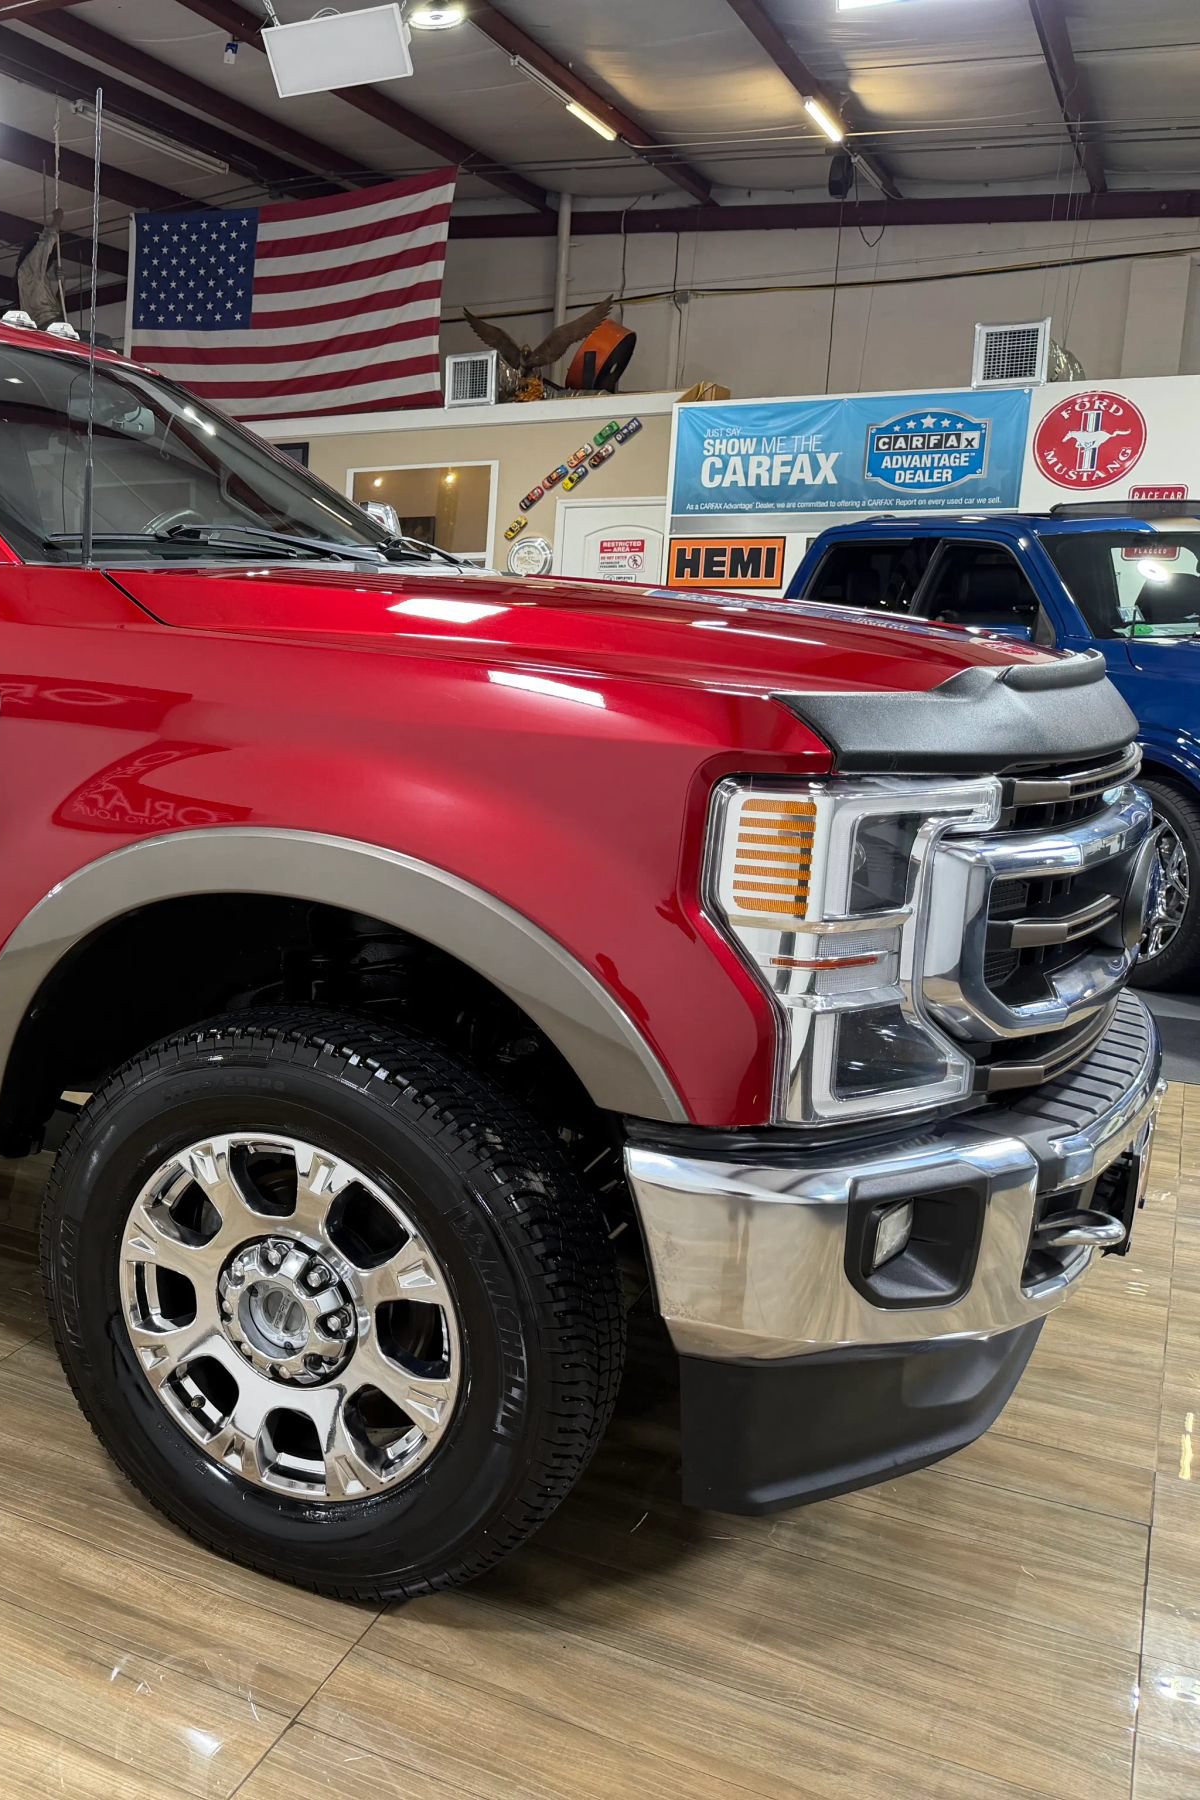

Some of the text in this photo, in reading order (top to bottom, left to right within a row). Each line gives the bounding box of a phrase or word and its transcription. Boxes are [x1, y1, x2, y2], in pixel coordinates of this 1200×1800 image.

[1060, 398, 1124, 420] FORD
[704, 427, 741, 438] JUST SAY
[877, 434, 977, 449] CARFAX
[703, 435, 823, 455] SHOW ME THE
[701, 452, 841, 488] CARFAX
[1044, 447, 1132, 482] MUSTANG
[895, 469, 952, 483] DEALER
[700, 502, 722, 510] CARFAX
[755, 501, 776, 509] Dealer,
[797, 500, 828, 508] committed
[837, 499, 860, 508] offering
[896, 498, 917, 507] Report
[988, 496, 1002, 504] sell.
[1134, 491, 1183, 500] RACE CAR
[674, 547, 777, 579] HEMI
[469, 1257, 528, 1438] MICHELIN
